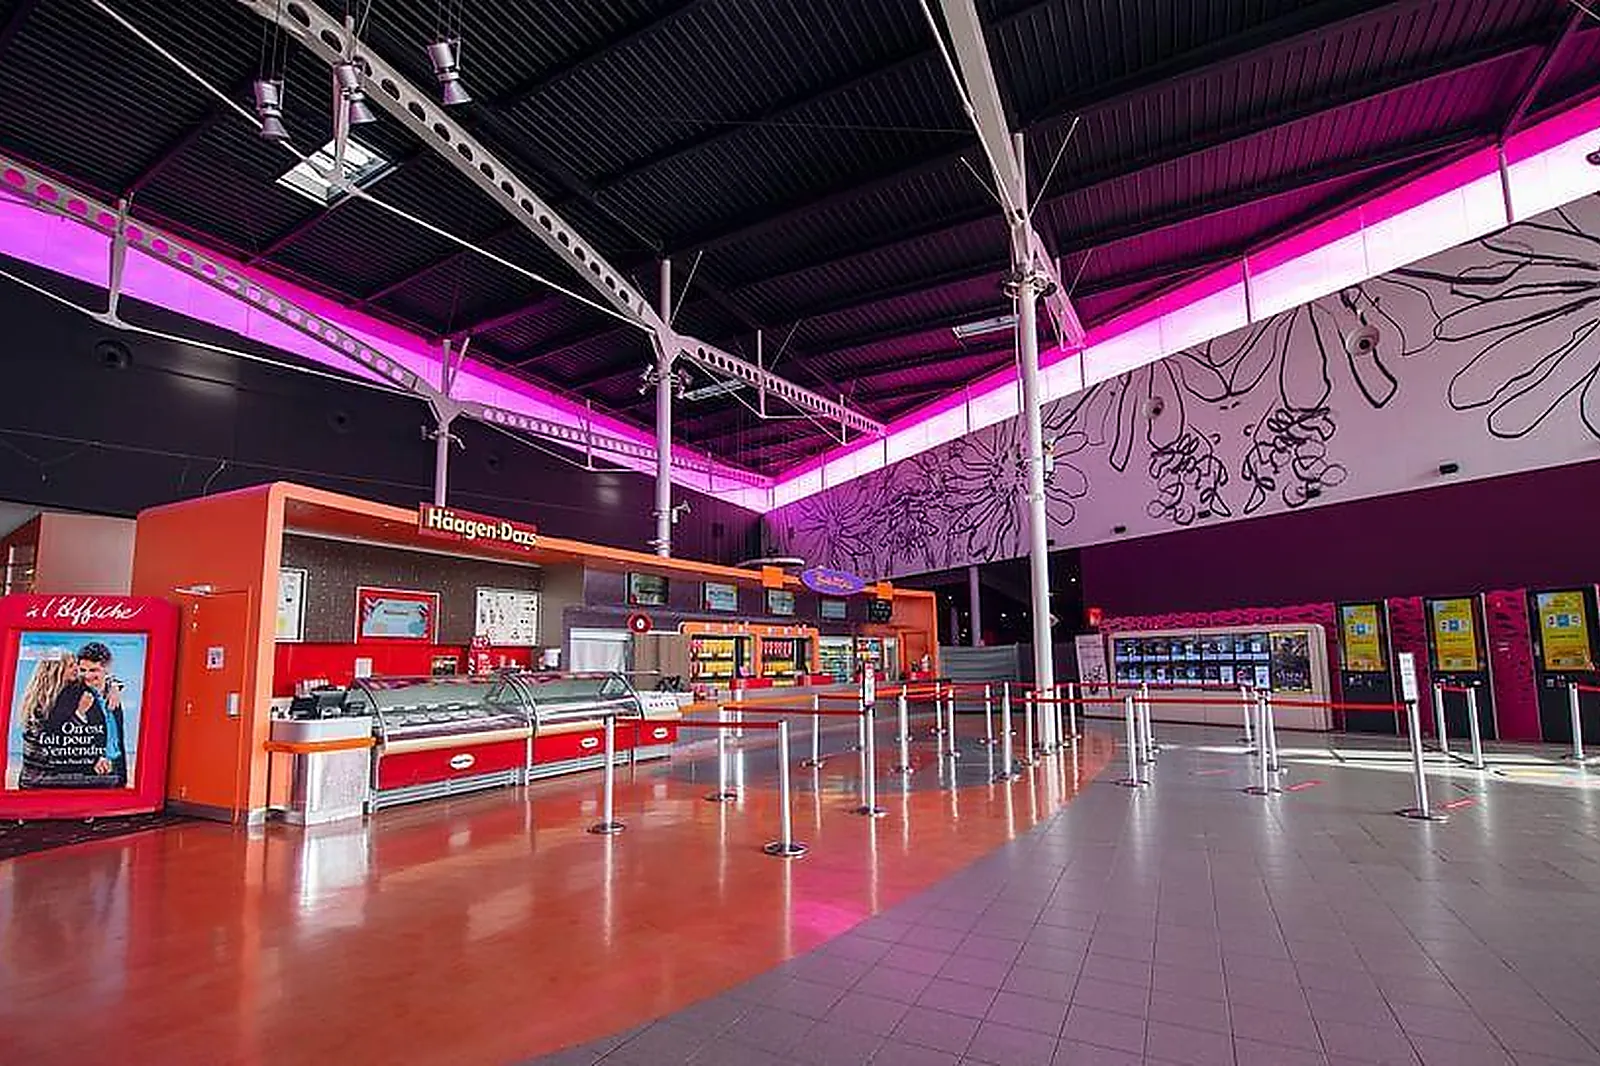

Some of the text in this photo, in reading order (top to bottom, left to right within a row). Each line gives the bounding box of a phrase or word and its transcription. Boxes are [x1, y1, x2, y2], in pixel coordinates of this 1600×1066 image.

[61, 722, 105, 735] On est
[39, 732, 95, 747] fait pour
